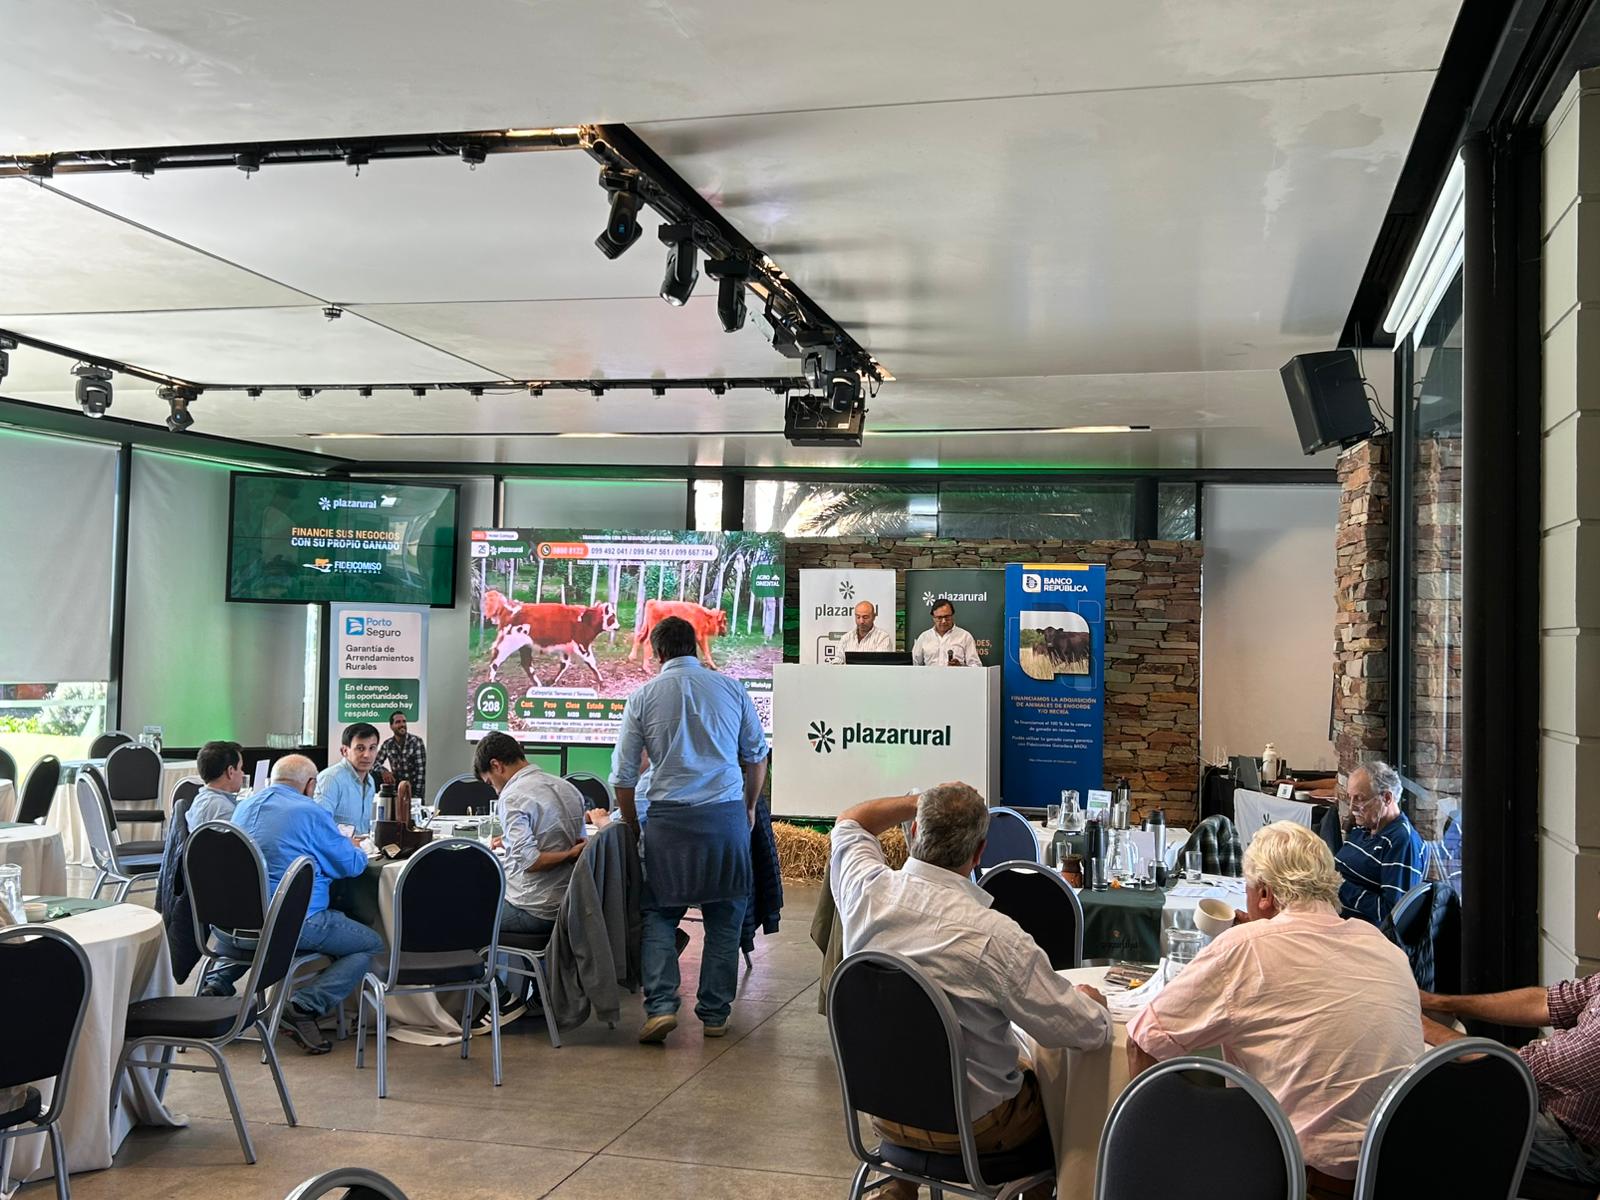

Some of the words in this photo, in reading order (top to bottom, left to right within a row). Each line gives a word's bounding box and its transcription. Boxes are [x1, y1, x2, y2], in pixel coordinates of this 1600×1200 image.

[333, 498, 377, 509] plazarural
[292, 527, 334, 538] FINANCIE
[336, 529, 354, 539] SUS
[356, 530, 401, 541] NEGOCIOS
[291, 537, 311, 547] CON
[313, 538, 325, 548] SU
[327, 539, 361, 549] PROPIO
[362, 540, 400, 550] GANADO
[604, 547, 615, 555] 492
[616, 547, 628, 555] 041
[334, 561, 382, 570] FIDEICOMISO
[1043, 577, 1073, 585] BANCO
[1043, 583, 1088, 592] REPÚBLICA
[815, 603, 878, 620] plazarl
[366, 617, 392, 626] Porto
[366, 627, 401, 638] Seguro
[384, 645, 395, 653] de
[346, 654, 415, 662] Arrendamientos
[346, 663, 377, 671] Rurales
[364, 685, 389, 693] campo
[356, 693, 408, 701] oportunidades
[399, 701, 413, 710] hay
[482, 700, 500, 712] 208
[344, 710, 380, 718] respaldo.
[842, 722, 951, 750] plazarural
